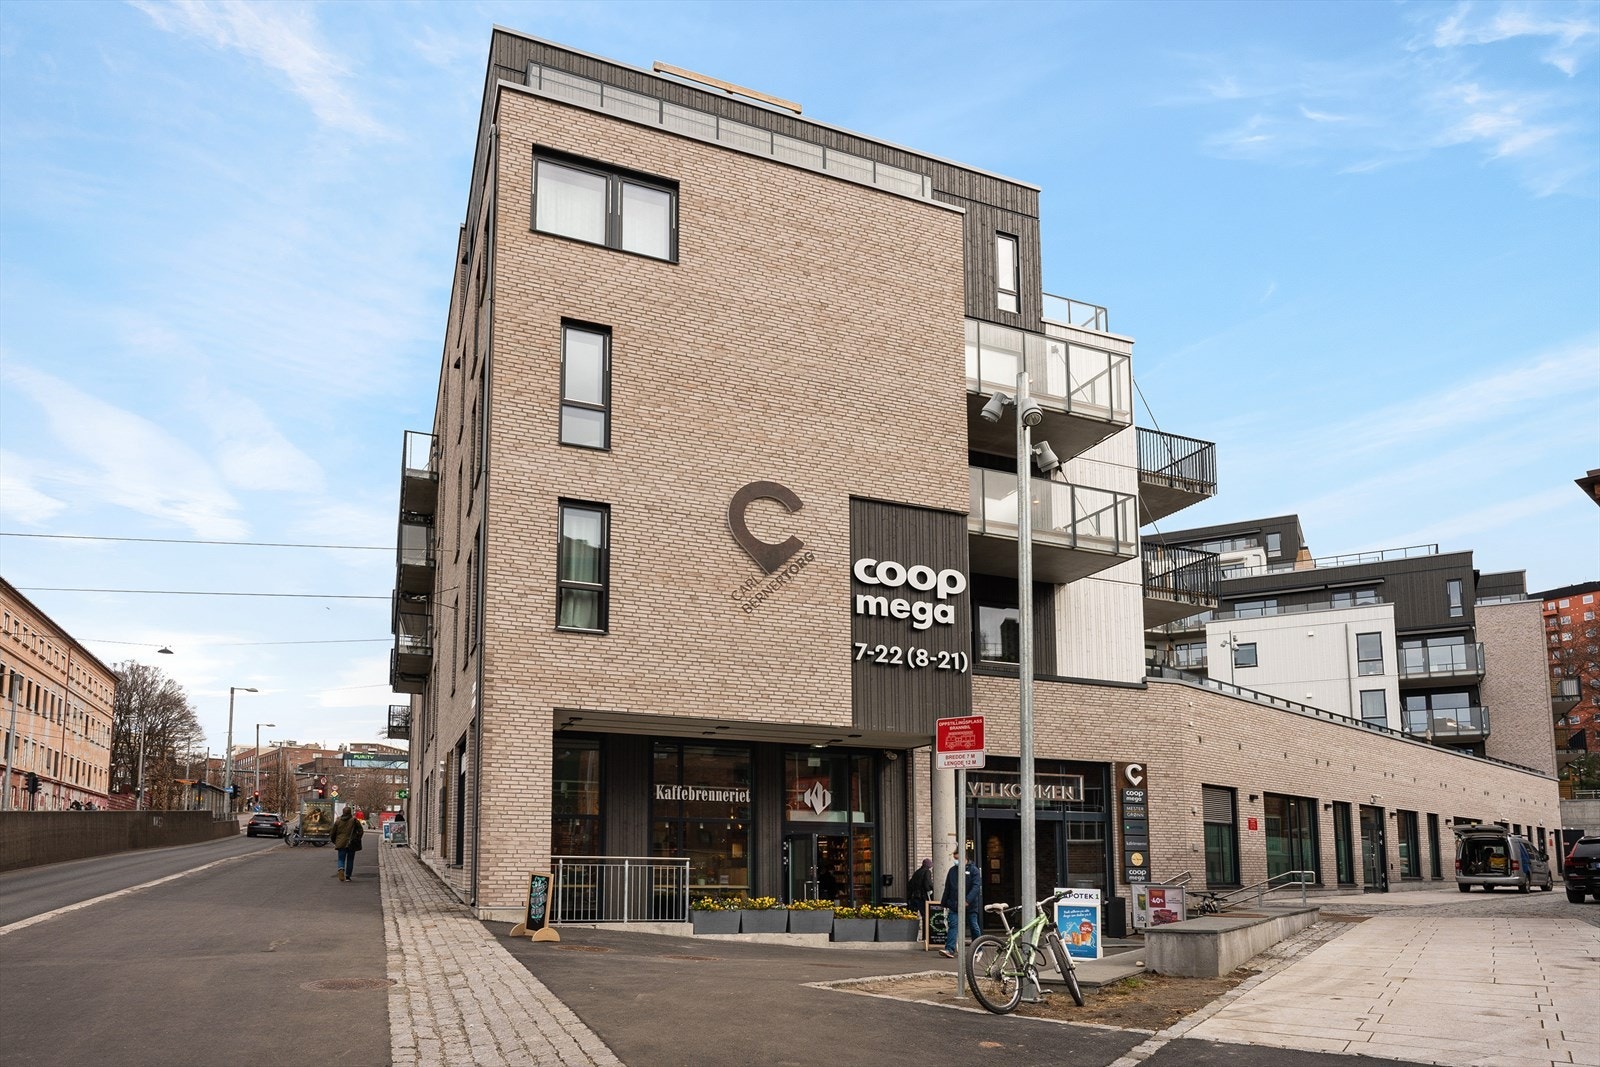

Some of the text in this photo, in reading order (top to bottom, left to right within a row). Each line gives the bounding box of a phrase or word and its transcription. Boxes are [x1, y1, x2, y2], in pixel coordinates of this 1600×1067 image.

[731, 575, 763, 601] CARL
[741, 551, 815, 615] BERNERTORG
[853, 557, 967, 600] coop
[855, 593, 955, 630] mega
[854, 642, 968, 674] 7-22 (8-21)
[938, 719, 983, 727] OPPSTILLINGSPLASS
[655, 784, 752, 803] Kaffebrenneriet
[967, 781, 1075, 800] VELKOMEN
[1126, 790, 1143, 798] coop
